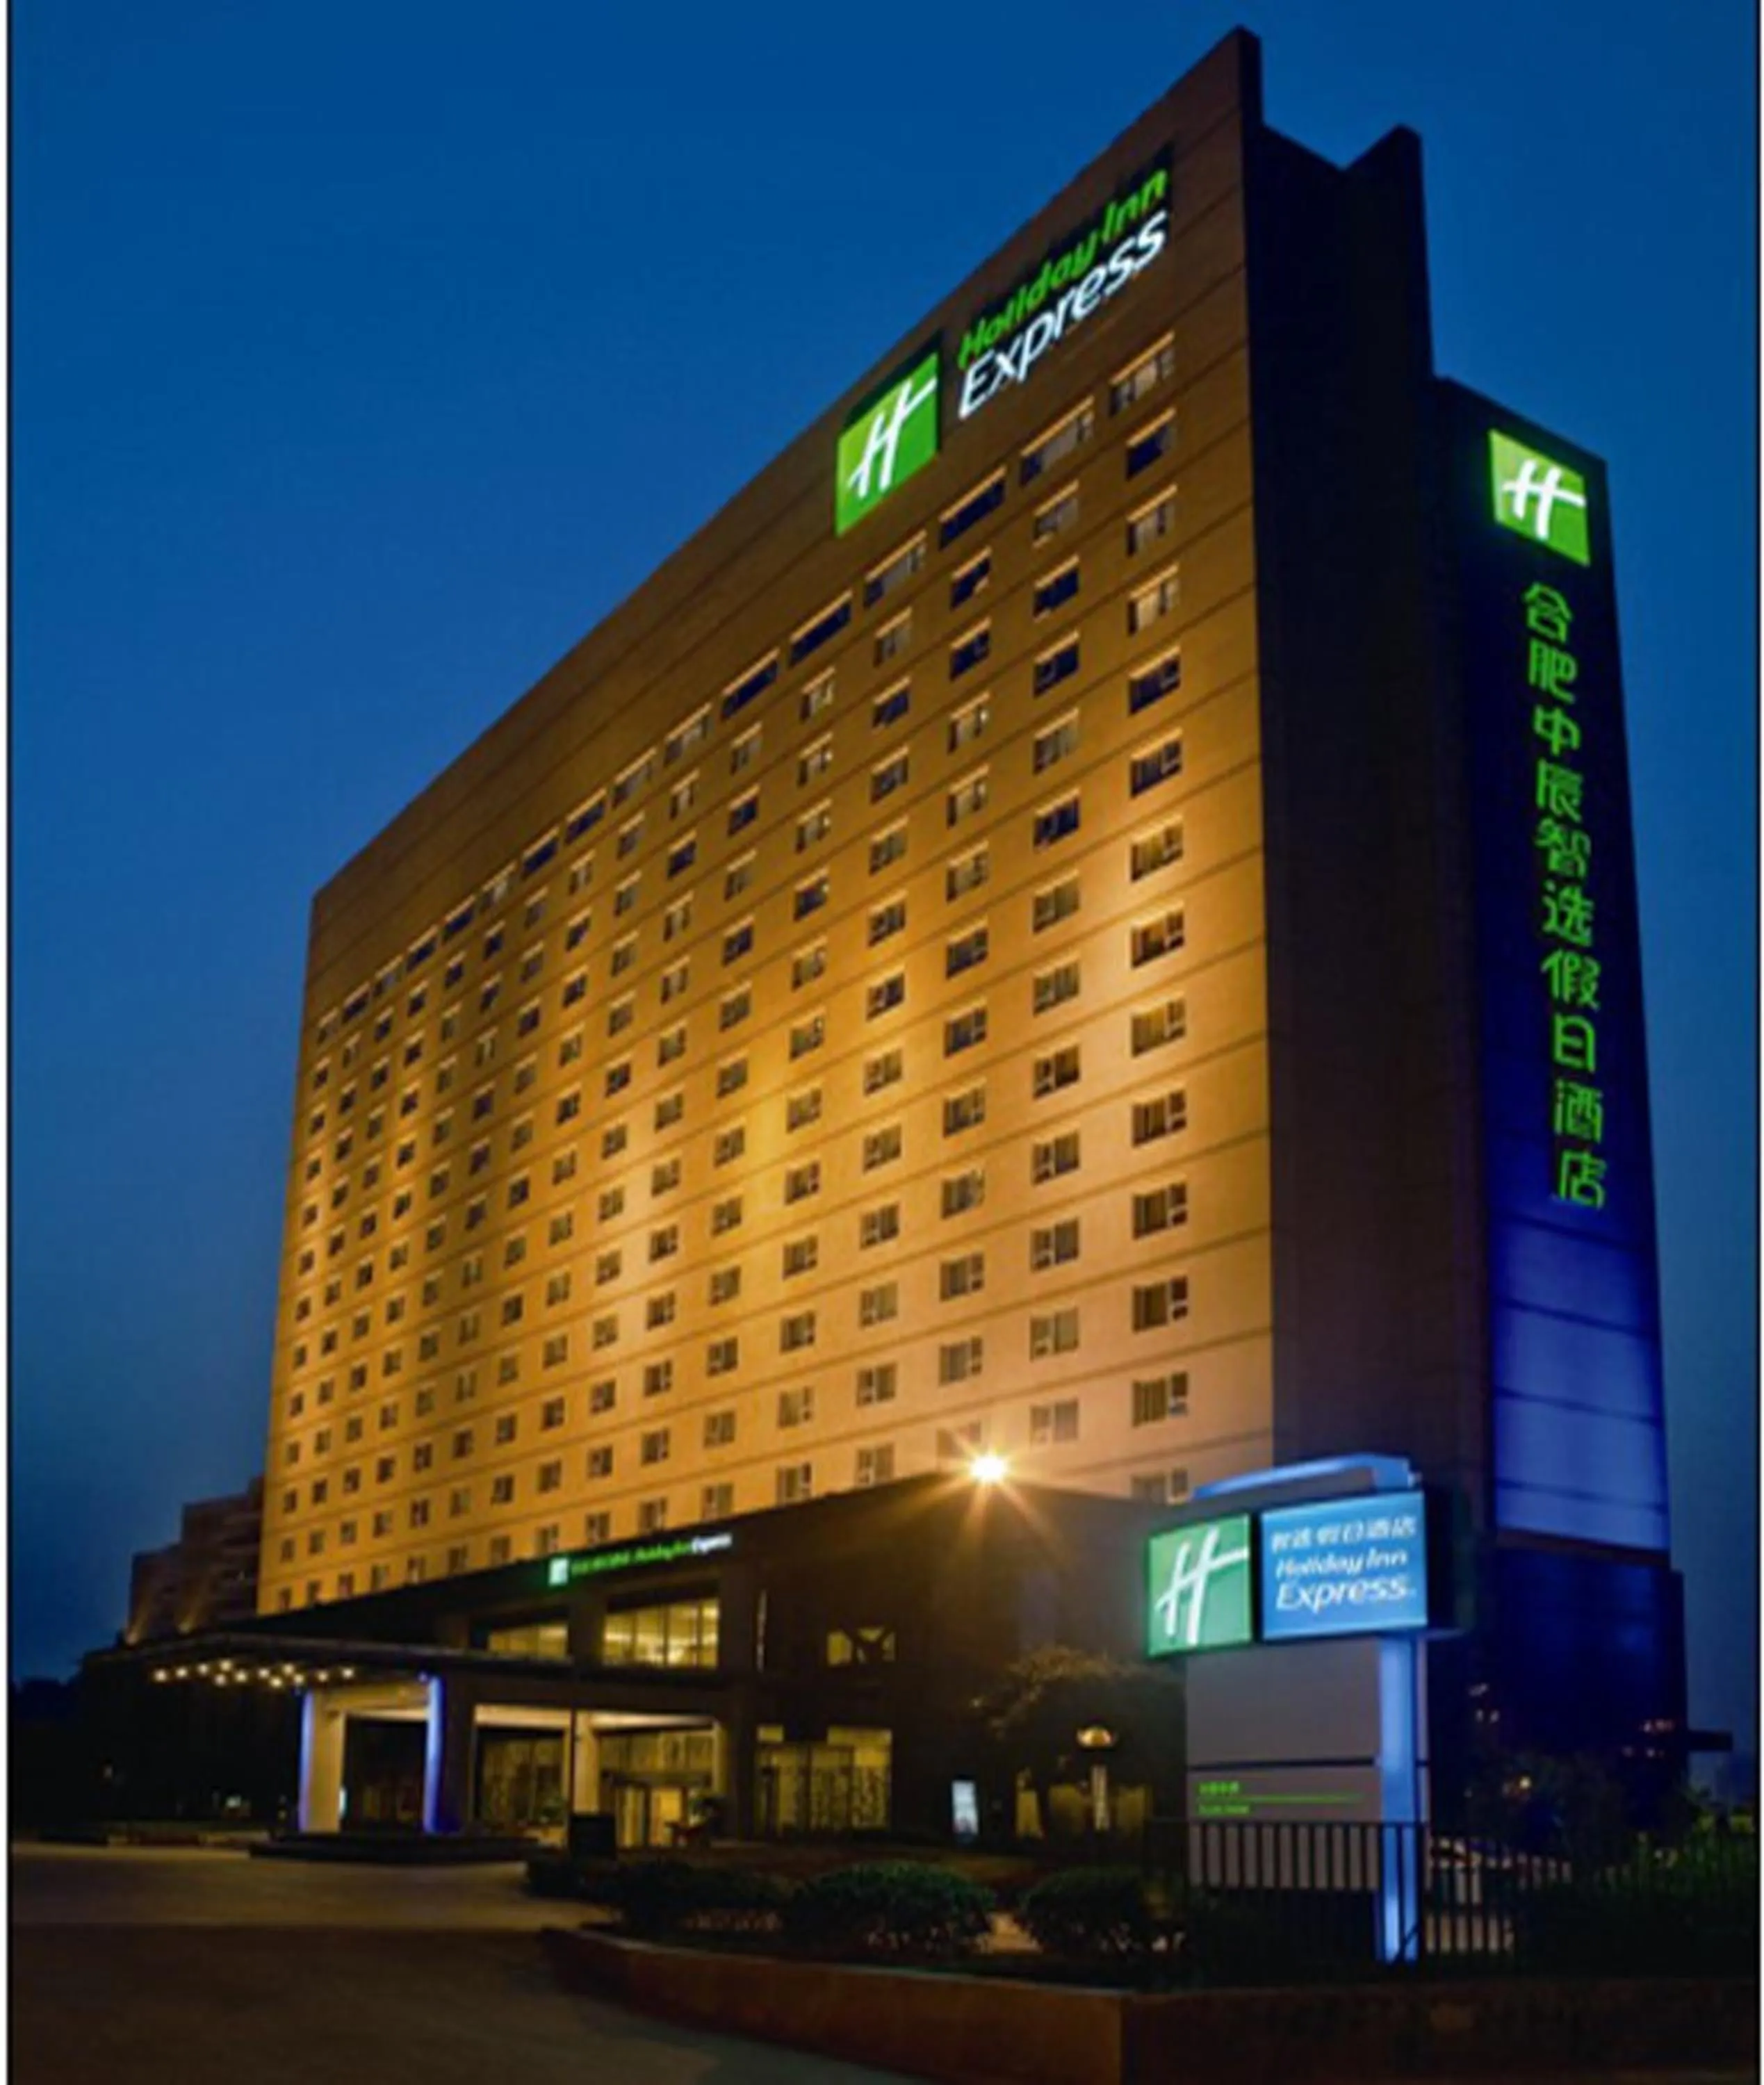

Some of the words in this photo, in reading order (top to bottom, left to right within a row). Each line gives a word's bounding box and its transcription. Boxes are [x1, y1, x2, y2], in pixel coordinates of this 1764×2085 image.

[958, 231, 1100, 370] Holiday
[1102, 170, 1168, 243] Inn
[958, 210, 1168, 418] Express
[1521, 581, 1607, 1209] 合肥中辰智选假日酒店
[1276, 1575, 1409, 1614] Express
[1366, 1547, 1408, 1569] Inn
